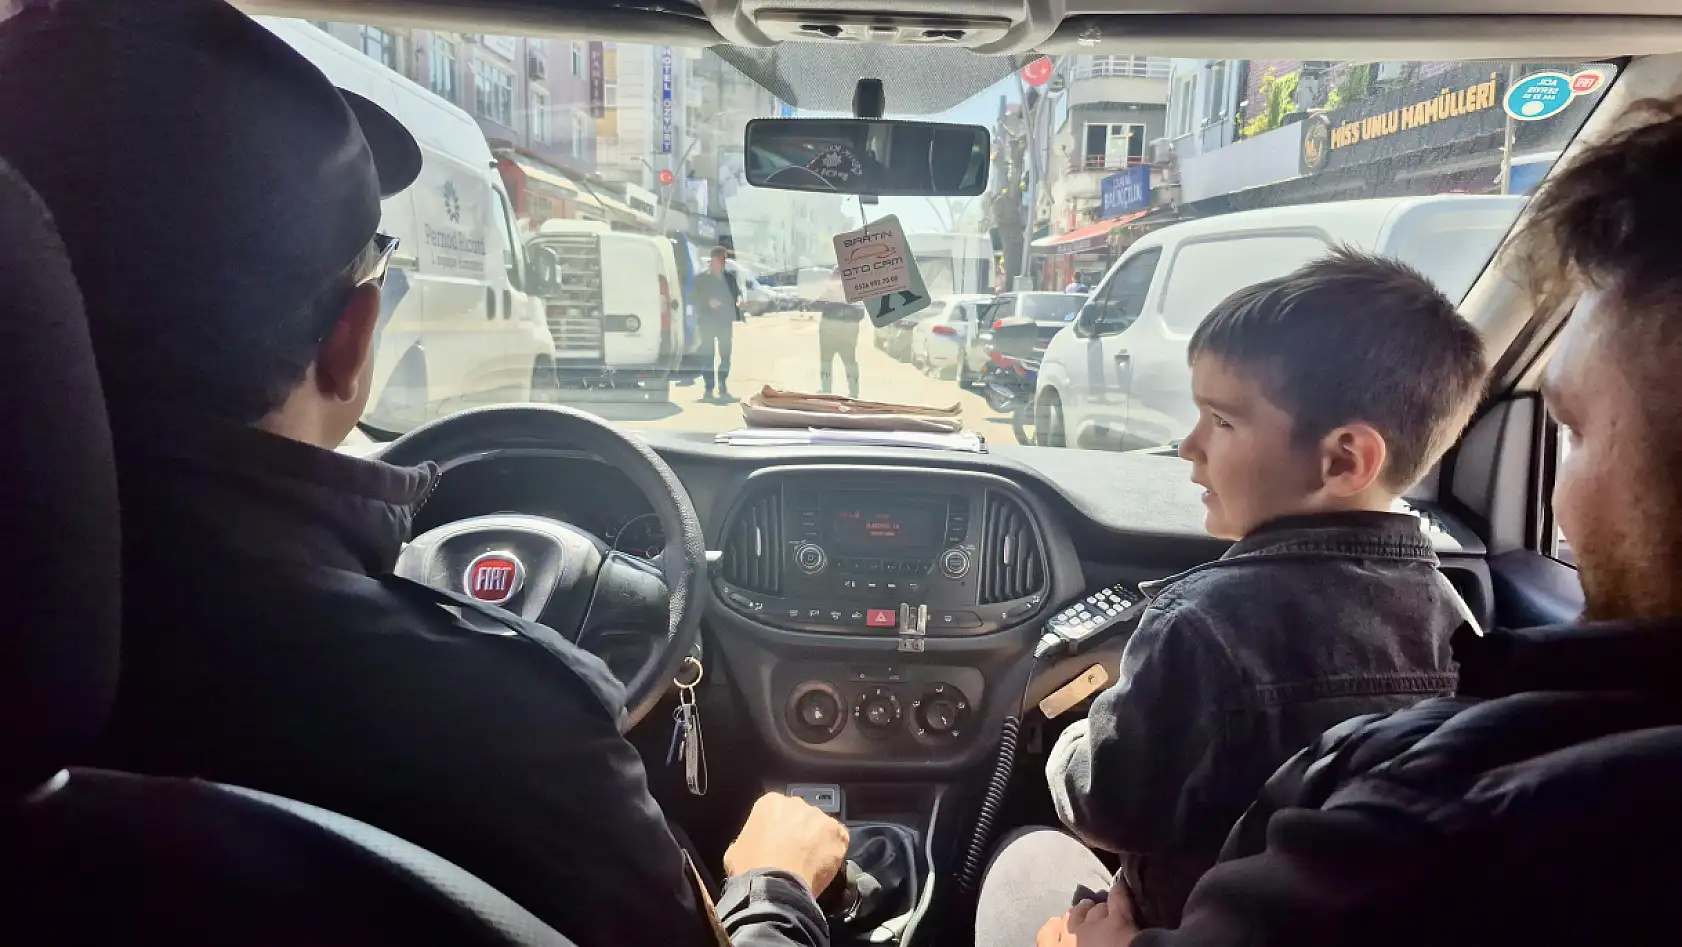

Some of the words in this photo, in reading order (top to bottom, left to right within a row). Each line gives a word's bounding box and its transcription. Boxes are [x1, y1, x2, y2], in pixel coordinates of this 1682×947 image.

[1361, 111, 1399, 140] UNLU
[1401, 72, 1497, 131] MAMÜLLERİ
[843, 229, 893, 248] BARTIN
[842, 264, 871, 277] OTO
[873, 257, 904, 271] CAM
[475, 566, 512, 591] FIAT
